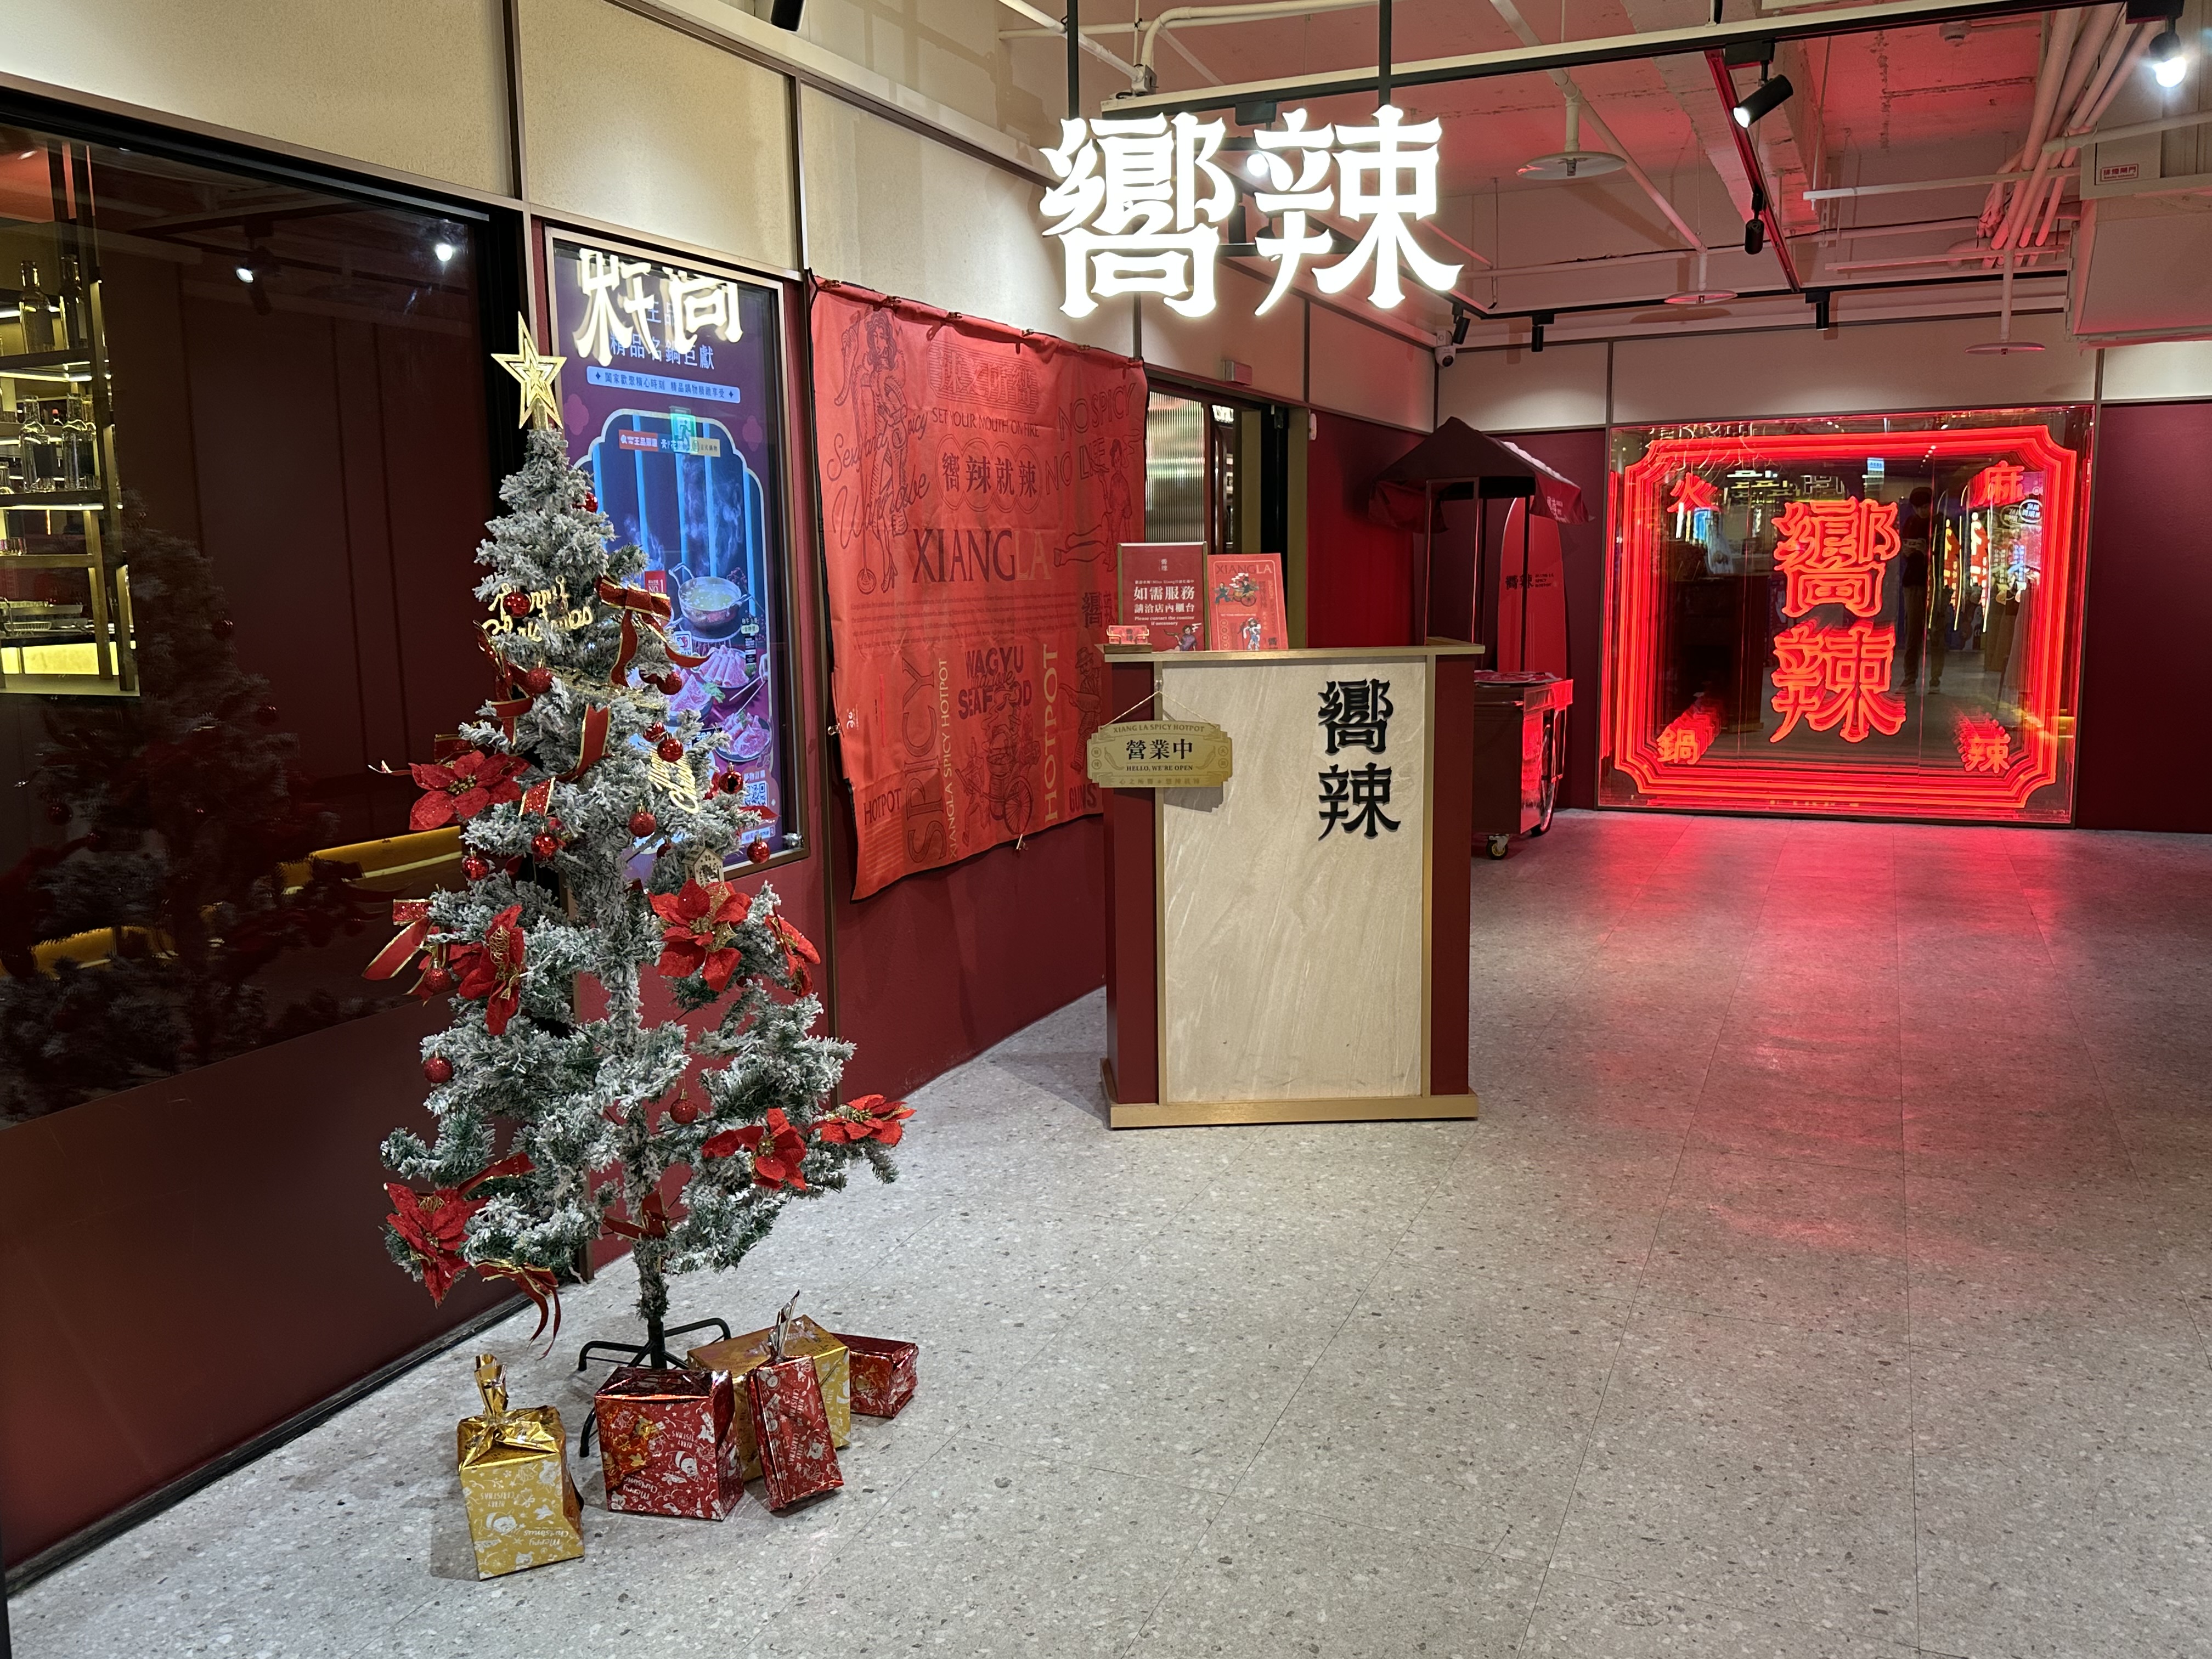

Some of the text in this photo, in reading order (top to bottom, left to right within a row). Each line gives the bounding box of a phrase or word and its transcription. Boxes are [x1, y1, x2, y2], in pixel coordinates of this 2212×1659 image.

[932, 407, 1040, 438] SET YOUR MOUTH ON FIRE
[1058, 382, 1137, 442] NO SPICY
[827, 433, 862, 481] Sexy
[1045, 452, 1073, 495] NO
[1667, 472, 1719, 513] 火
[1980, 460, 2025, 502] 麻
[1133, 585, 1195, 601] 如需服務
[1134, 603, 1194, 613] 請洽店內櫃台
[964, 645, 1024, 679] WAGYU
[1043, 644, 1058, 822] HOTPOT
[1113, 724, 1137, 733] XIANG
[1173, 724, 1205, 732] HOTPOT
[1126, 738, 1193, 760] 營業中
[1657, 727, 1701, 765] 鍋
[902, 657, 947, 864] SPICY
[938, 658, 957, 859] XIANGLA SPICY HOTPOT
[1965, 731, 2011, 774] 辣
[864, 788, 901, 825] HOTPOT
